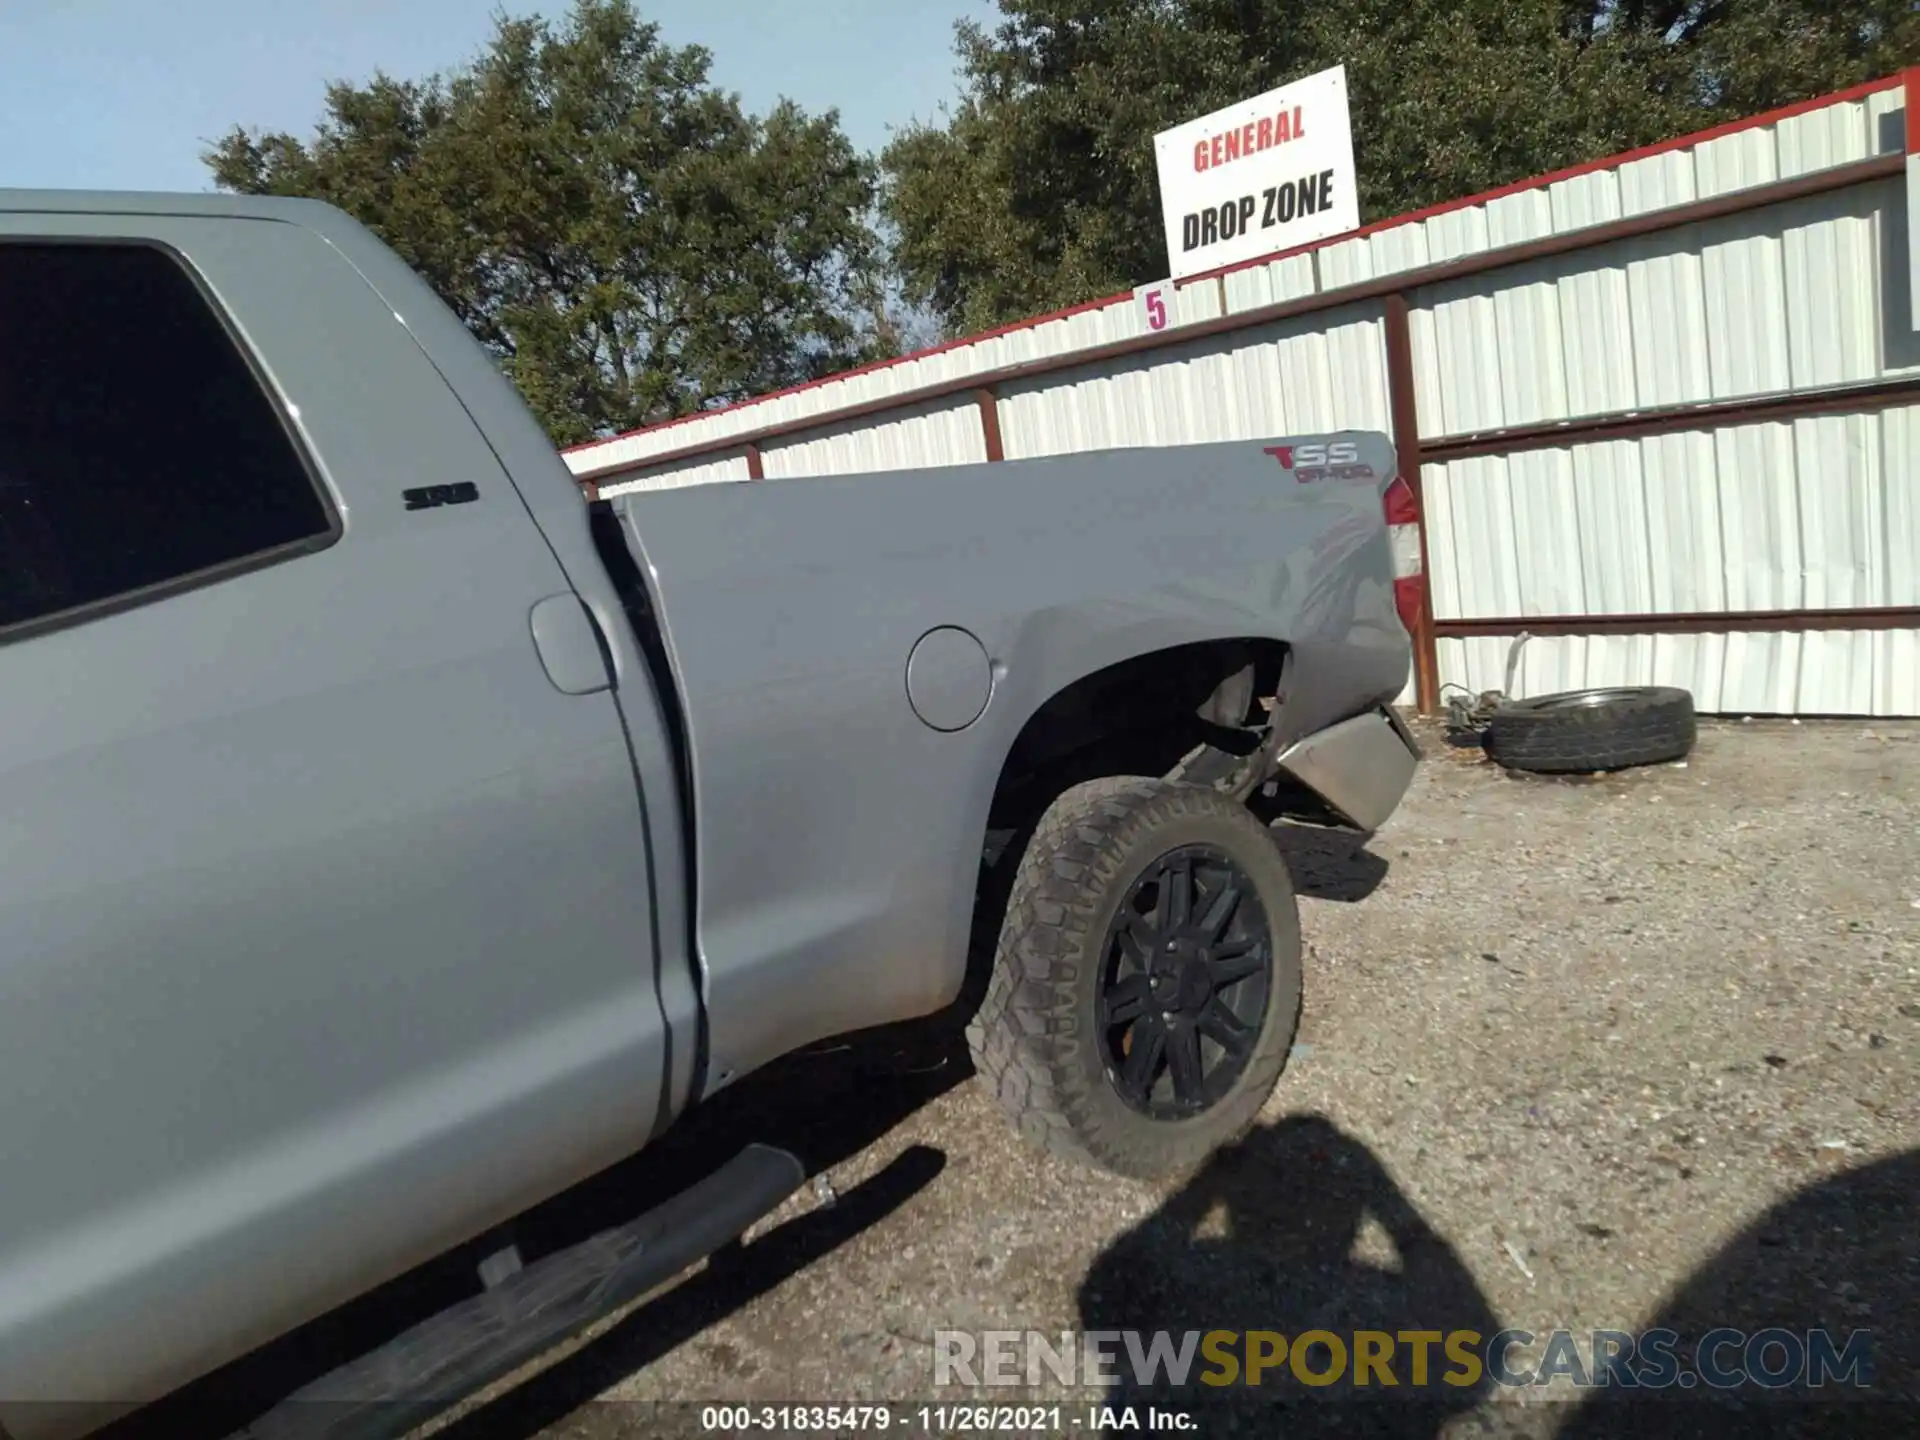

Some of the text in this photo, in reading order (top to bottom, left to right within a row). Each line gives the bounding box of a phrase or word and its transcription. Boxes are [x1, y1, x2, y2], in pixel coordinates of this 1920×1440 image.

[1194, 106, 1305, 173] GENERAL
[1183, 168, 1334, 252] DROP ZONE
[1146, 291, 1166, 330] 5
